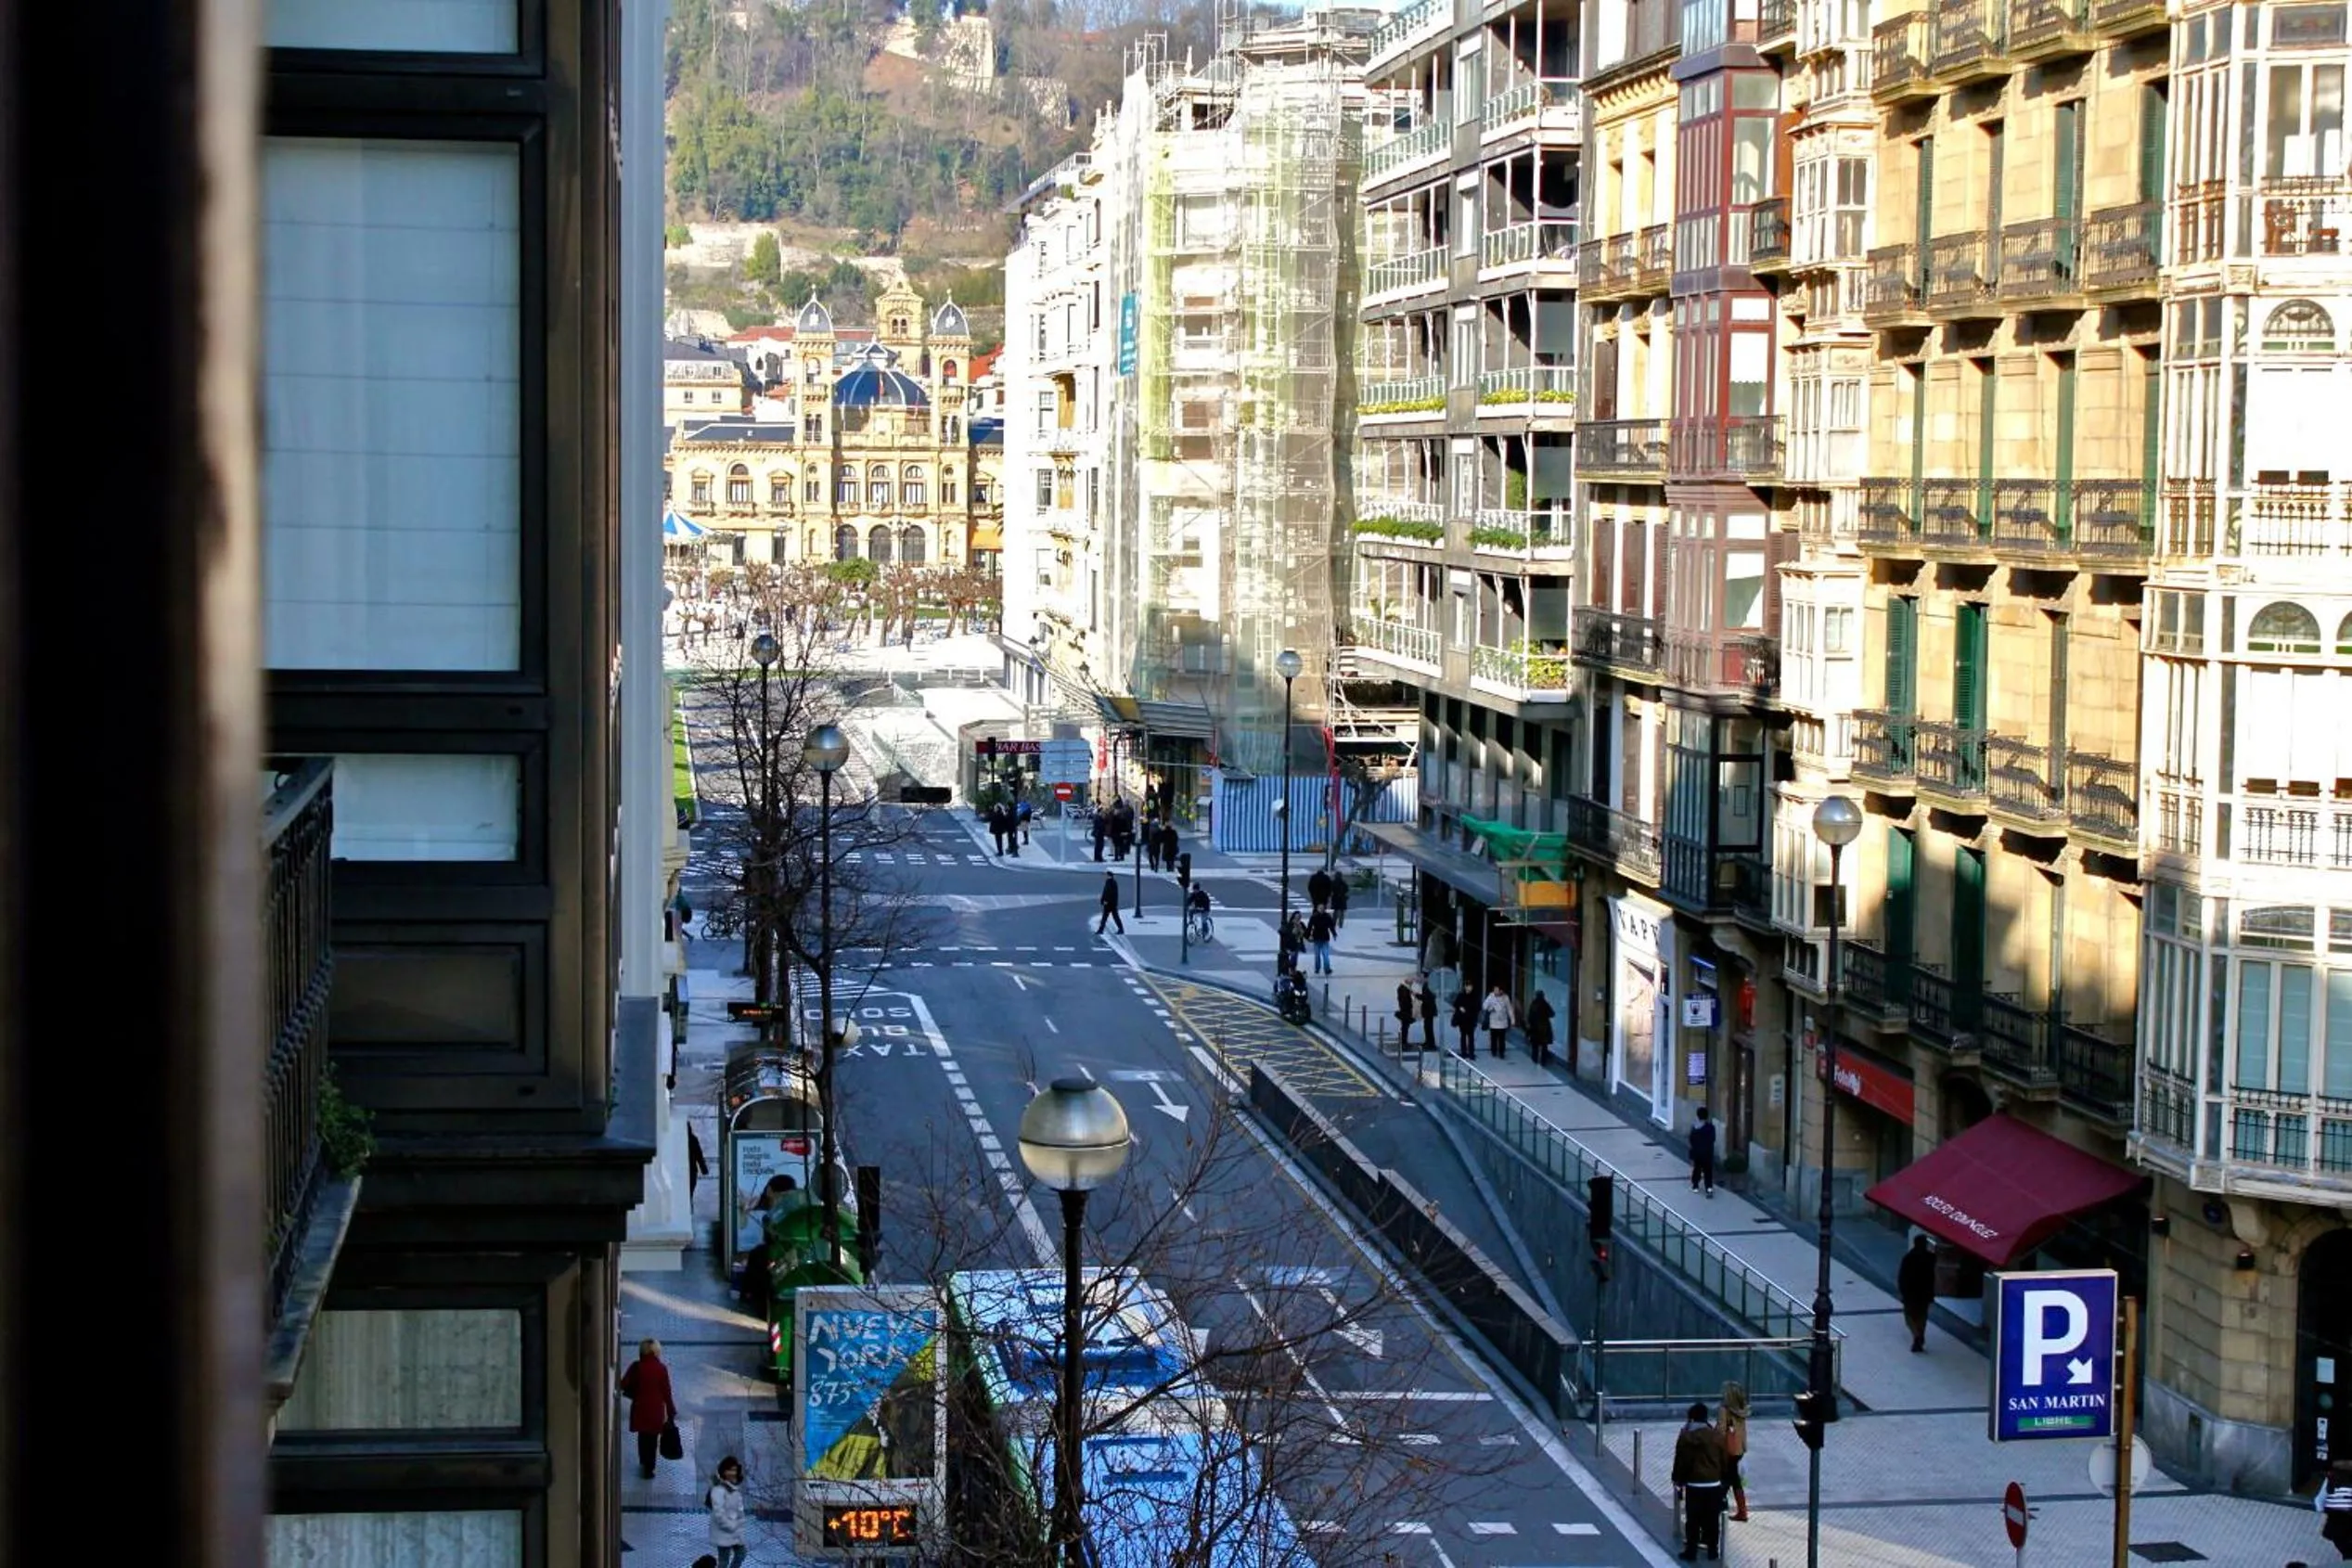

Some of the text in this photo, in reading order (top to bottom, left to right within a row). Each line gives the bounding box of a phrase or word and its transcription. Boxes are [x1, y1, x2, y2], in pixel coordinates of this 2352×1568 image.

[842, 1044, 927, 1058] TAX
[2022, 1290, 2088, 1386] P
[2008, 1394, 2106, 1410] SAN MARTIN
